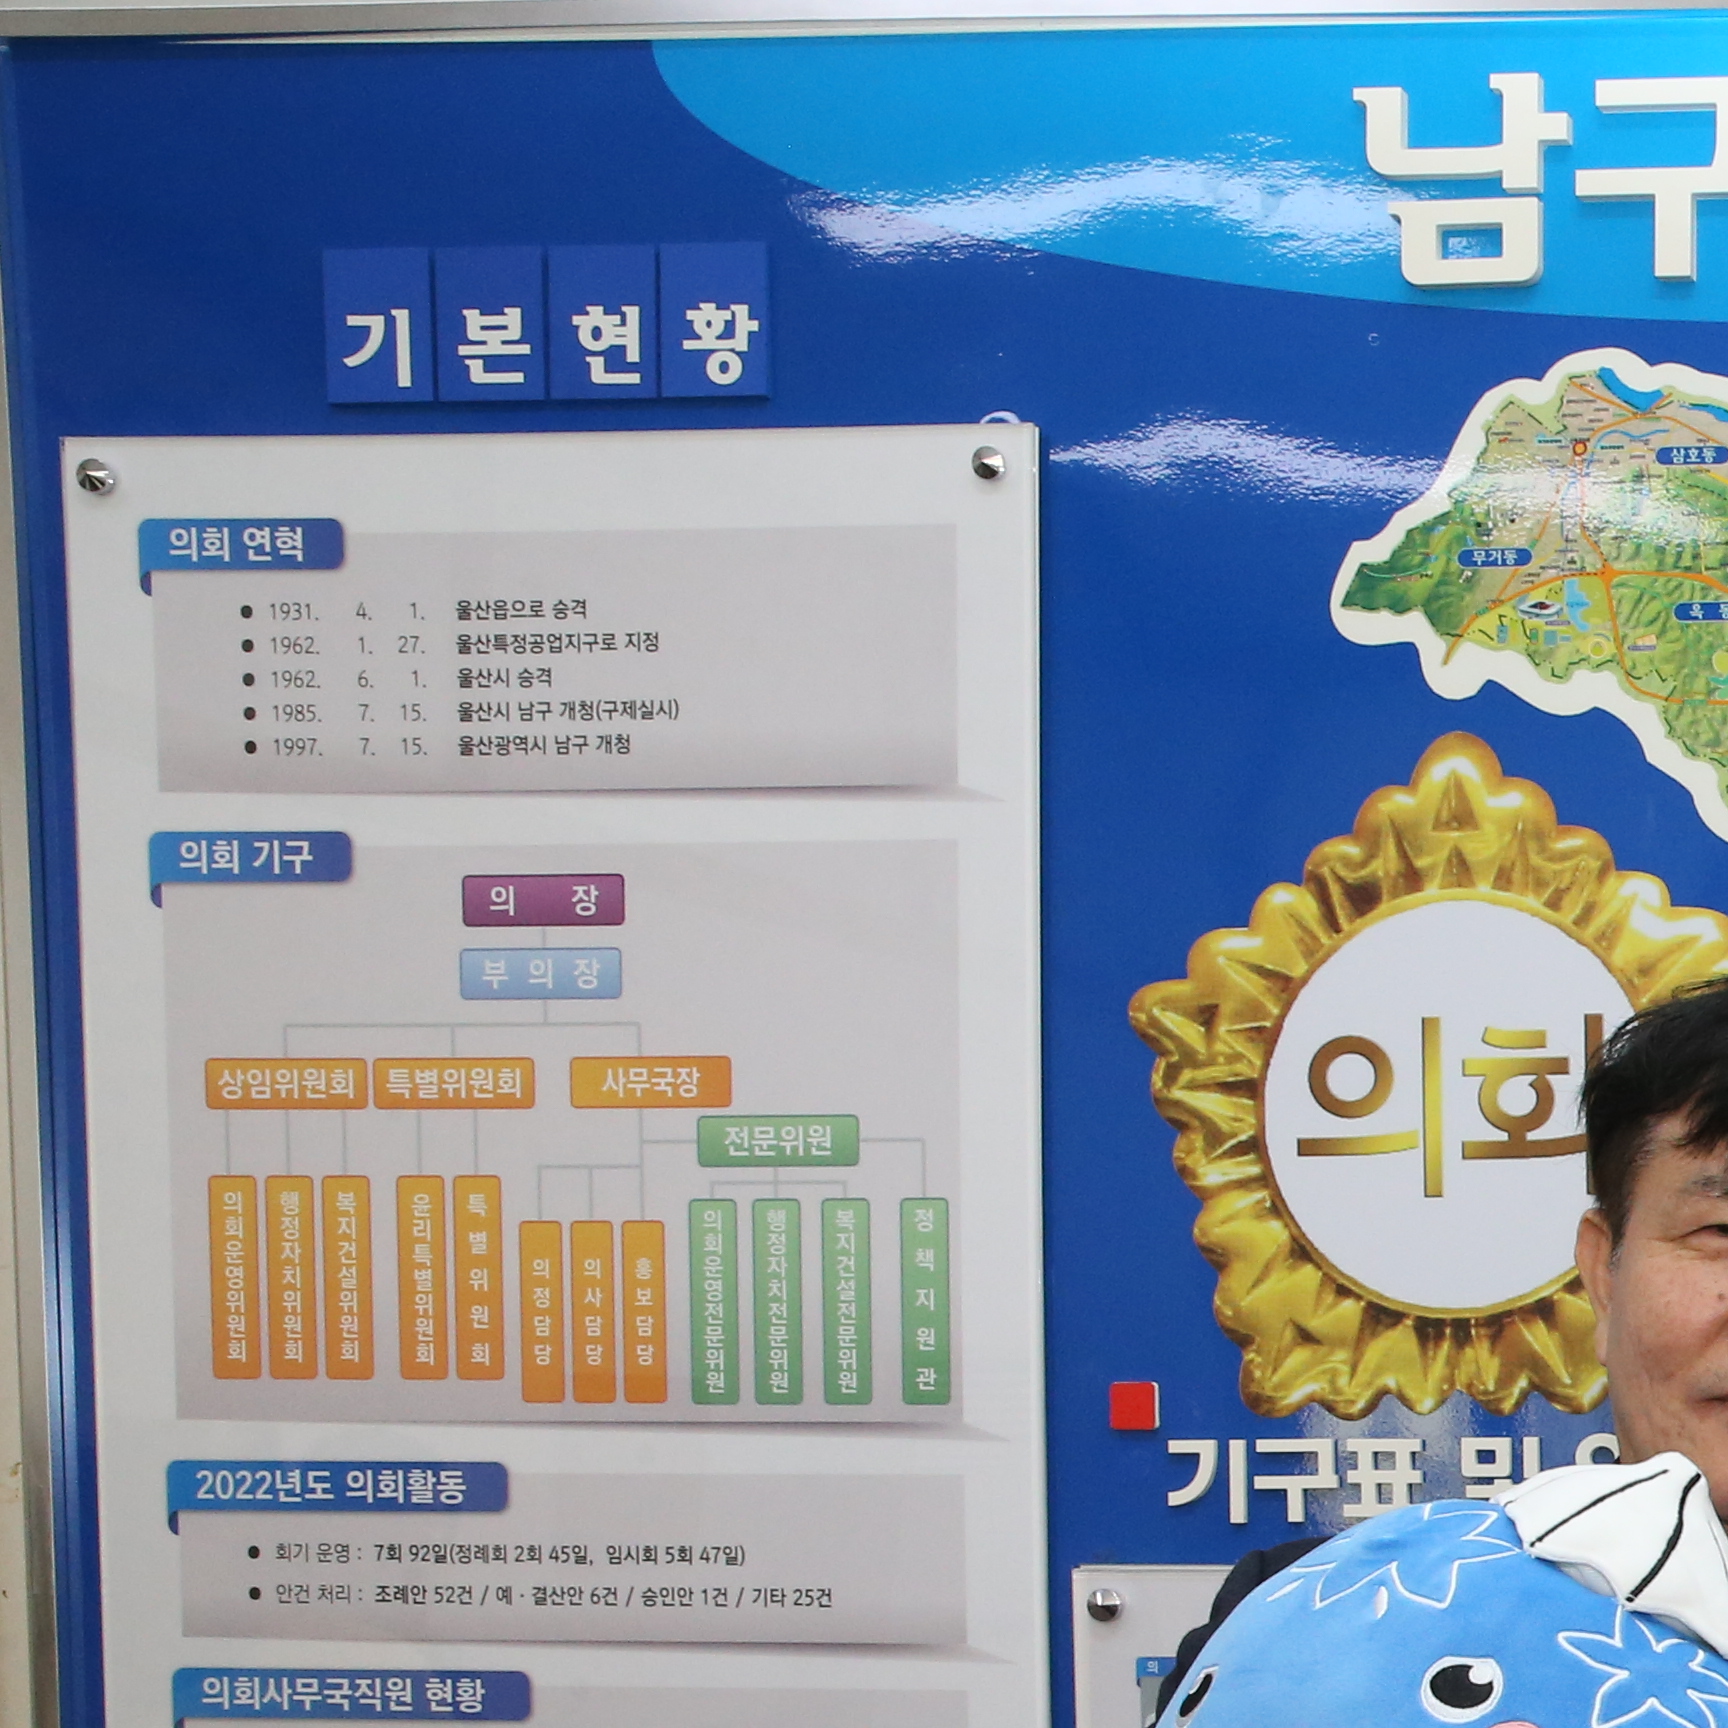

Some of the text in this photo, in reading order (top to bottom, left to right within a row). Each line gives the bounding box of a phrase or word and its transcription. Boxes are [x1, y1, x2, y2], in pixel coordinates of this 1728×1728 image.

[1671, 445, 1717, 464] 삼호동
[169, 526, 303, 562] 의회 연혁
[1472, 548, 1518, 567] 무거동
[269, 598, 587, 621] 1931. 울산읍으로 승격
[270, 631, 659, 655] 1962. 27. 울산특정공업지구로 지정
[271, 667, 552, 689] 1962. 울산시 승격
[272, 698, 680, 723] 1985. 15. 울산시 남구 개청(구제실시)
[273, 733, 631, 757] 1997. 15. 울산광역시 남구 개청
[179, 839, 313, 875] 의회 기구
[217, 1068, 354, 1100] 상임위원회
[385, 1067, 521, 1099] 특별위원회
[601, 1066, 701, 1098] 사무국장
[1297, 1013, 1596, 1198] 의회
[724, 1124, 832, 1156] 전문위원
[195, 1469, 467, 1505] 2022년도 의회활동
[1167, 1438, 1424, 1524] 기구표
[275, 1542, 309, 1563] 회기
[316, 1542, 350, 1564] 운영
[373, 1543, 402, 1564] 7회
[514, 1544, 542, 1565] 2회
[548, 1544, 594, 1566] 45일,
[606, 1545, 658, 1565] 임시회
[665, 1545, 693, 1566] 5회
[698, 1545, 745, 1567] 47일)
[275, 1584, 832, 1608] 안건 처리 조례안 52건 결산안 6건 승인안 1건 기타 25건
[201, 1676, 486, 1713] 의회사무국직원 현황
